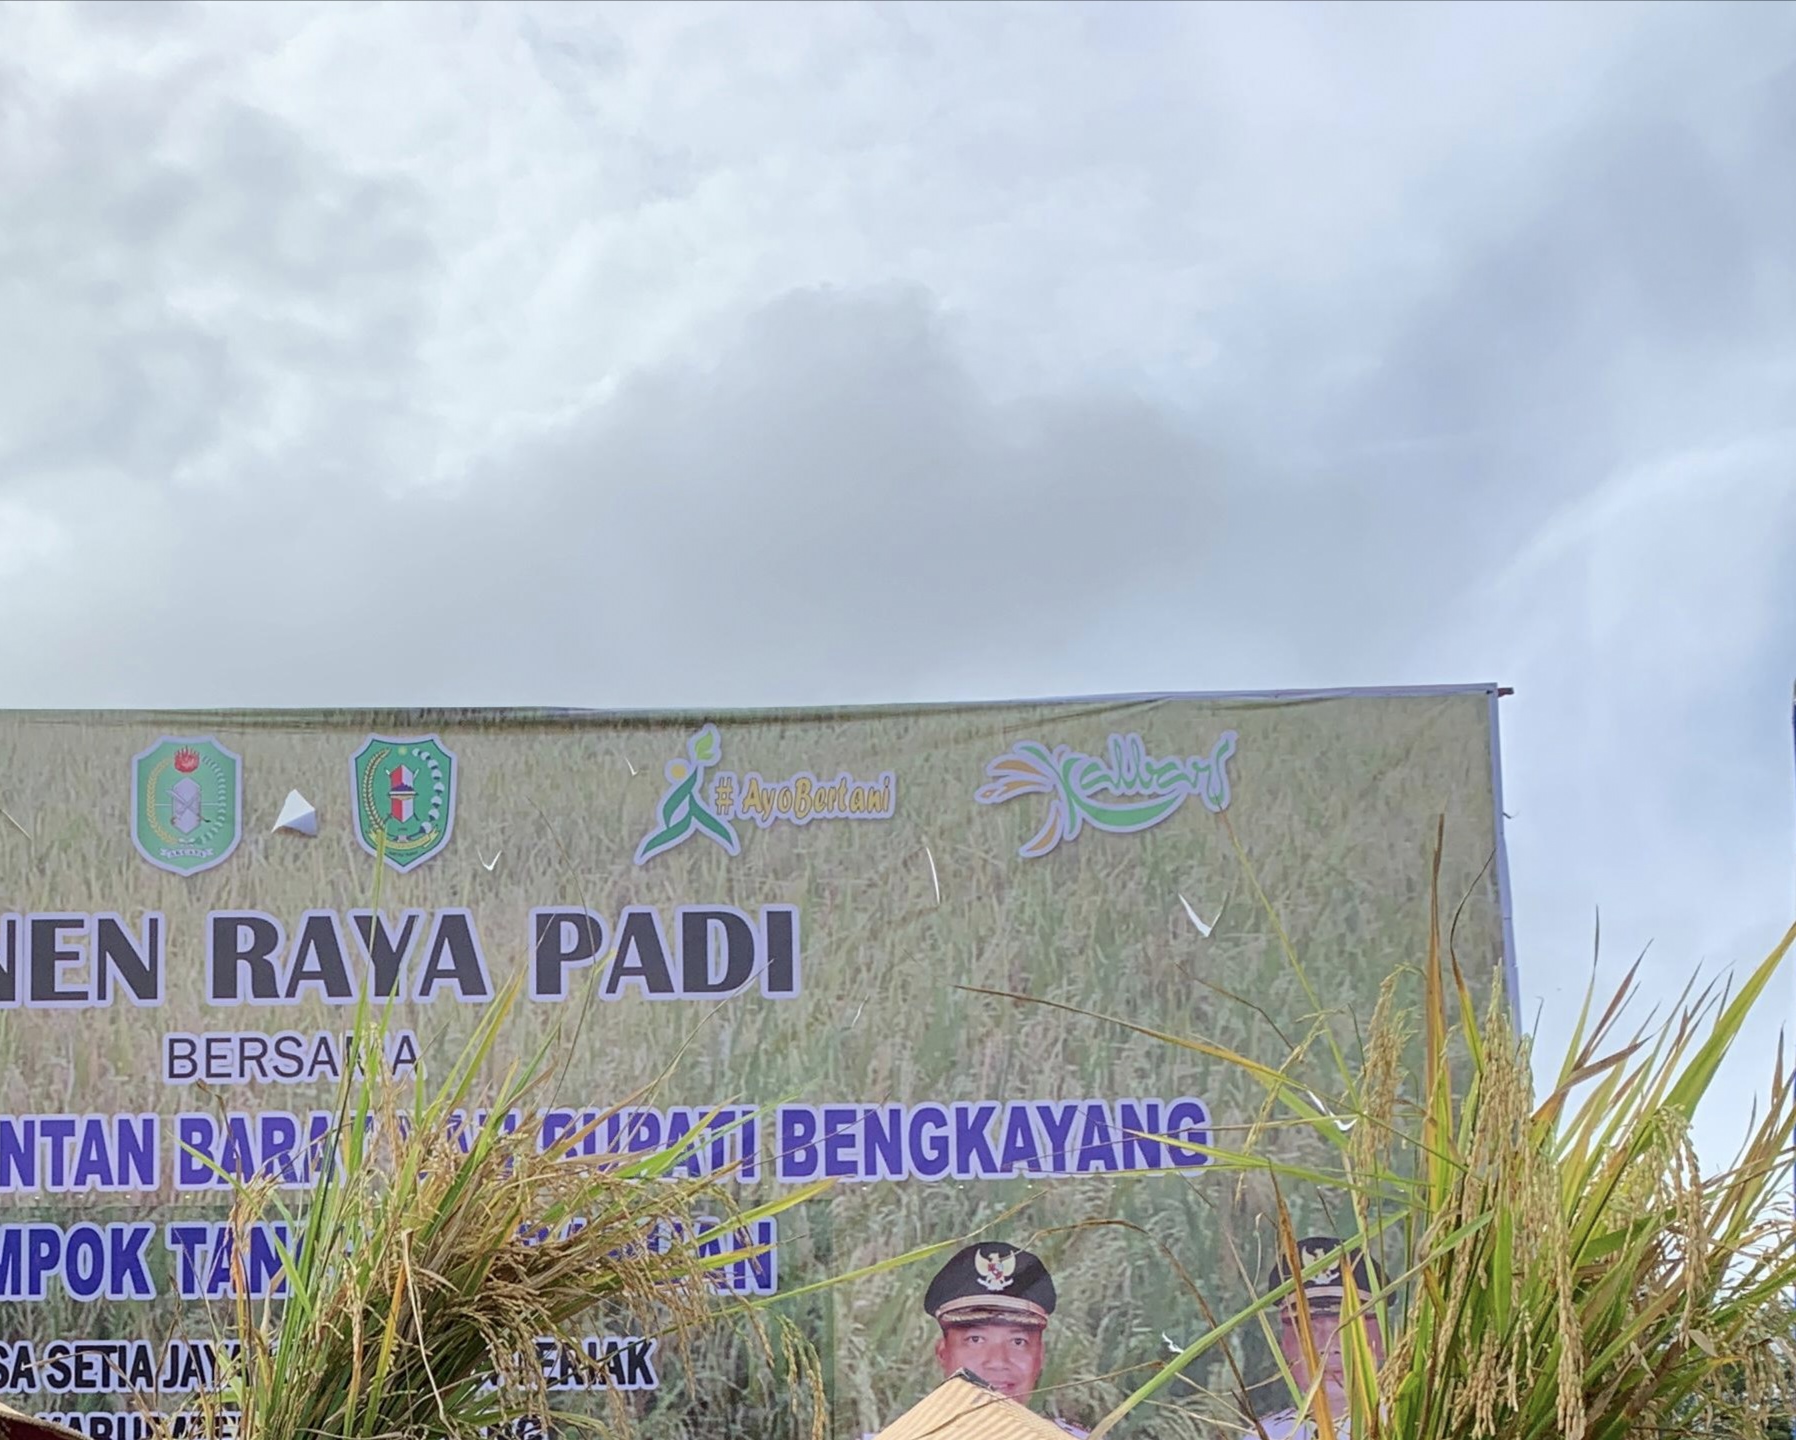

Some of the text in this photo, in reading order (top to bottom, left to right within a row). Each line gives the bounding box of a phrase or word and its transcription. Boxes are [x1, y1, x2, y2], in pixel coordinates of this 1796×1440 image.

[211, 915, 488, 1000] RAYA
[536, 910, 796, 995] PADI
[782, 1102, 1207, 1177] BENGKAYANG
[47, 1345, 153, 1388] SETIA
